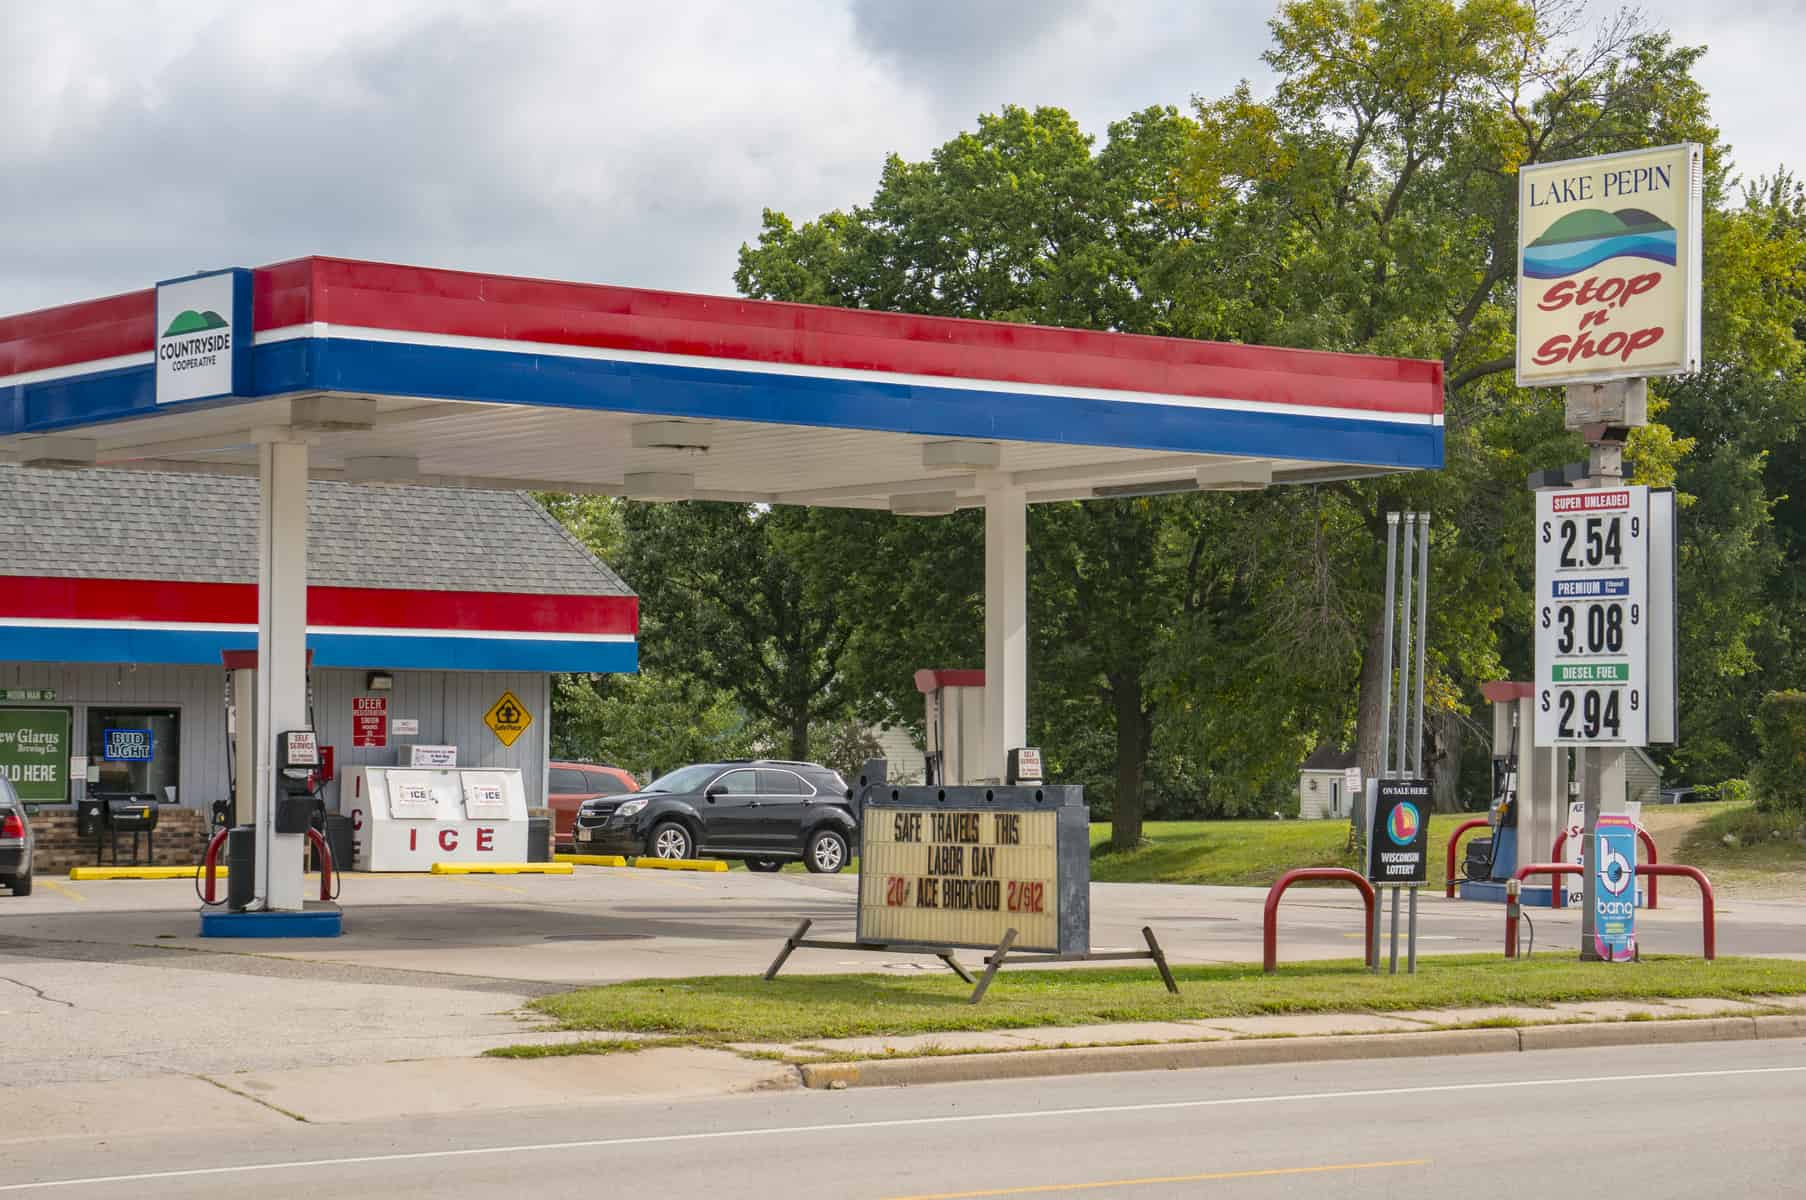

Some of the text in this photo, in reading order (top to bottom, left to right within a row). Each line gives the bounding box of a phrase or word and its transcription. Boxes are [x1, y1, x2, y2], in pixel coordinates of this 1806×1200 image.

[1530, 164, 1672, 207] LAKE PEPIN
[1537, 271, 1662, 312] Stop
[160, 333, 230, 360] COUNTRYSIDE
[1531, 326, 1665, 366] Shop
[172, 354, 216, 372] COOPERATIVE
[1554, 492, 1628, 511] SUPER UNLEADED
[1558, 581, 1600, 595] PREMIUM
[1562, 665, 1618, 680] DIESEL FUEL
[358, 698, 382, 709] DEER
[17, 728, 60, 744] Glarus
[112, 732, 144, 746] BUD
[107, 744, 150, 758] LIGHT
[23, 764, 57, 782] HERE
[410, 791, 426, 799] ICE
[485, 791, 500, 800] ICE
[1382, 786, 1428, 795] ON SALE HERE
[894, 812, 1020, 845] SAFE TRAVELS THIS
[410, 827, 495, 851] ICE
[927, 846, 996, 877] LABOR DAY
[1381, 852, 1420, 863] WISCONSIN
[1386, 864, 1416, 875] LOTTERY
[916, 877, 939, 908] ACE
[942, 878, 1001, 911] BIRDFOOD
[1597, 896, 1633, 918] bang
